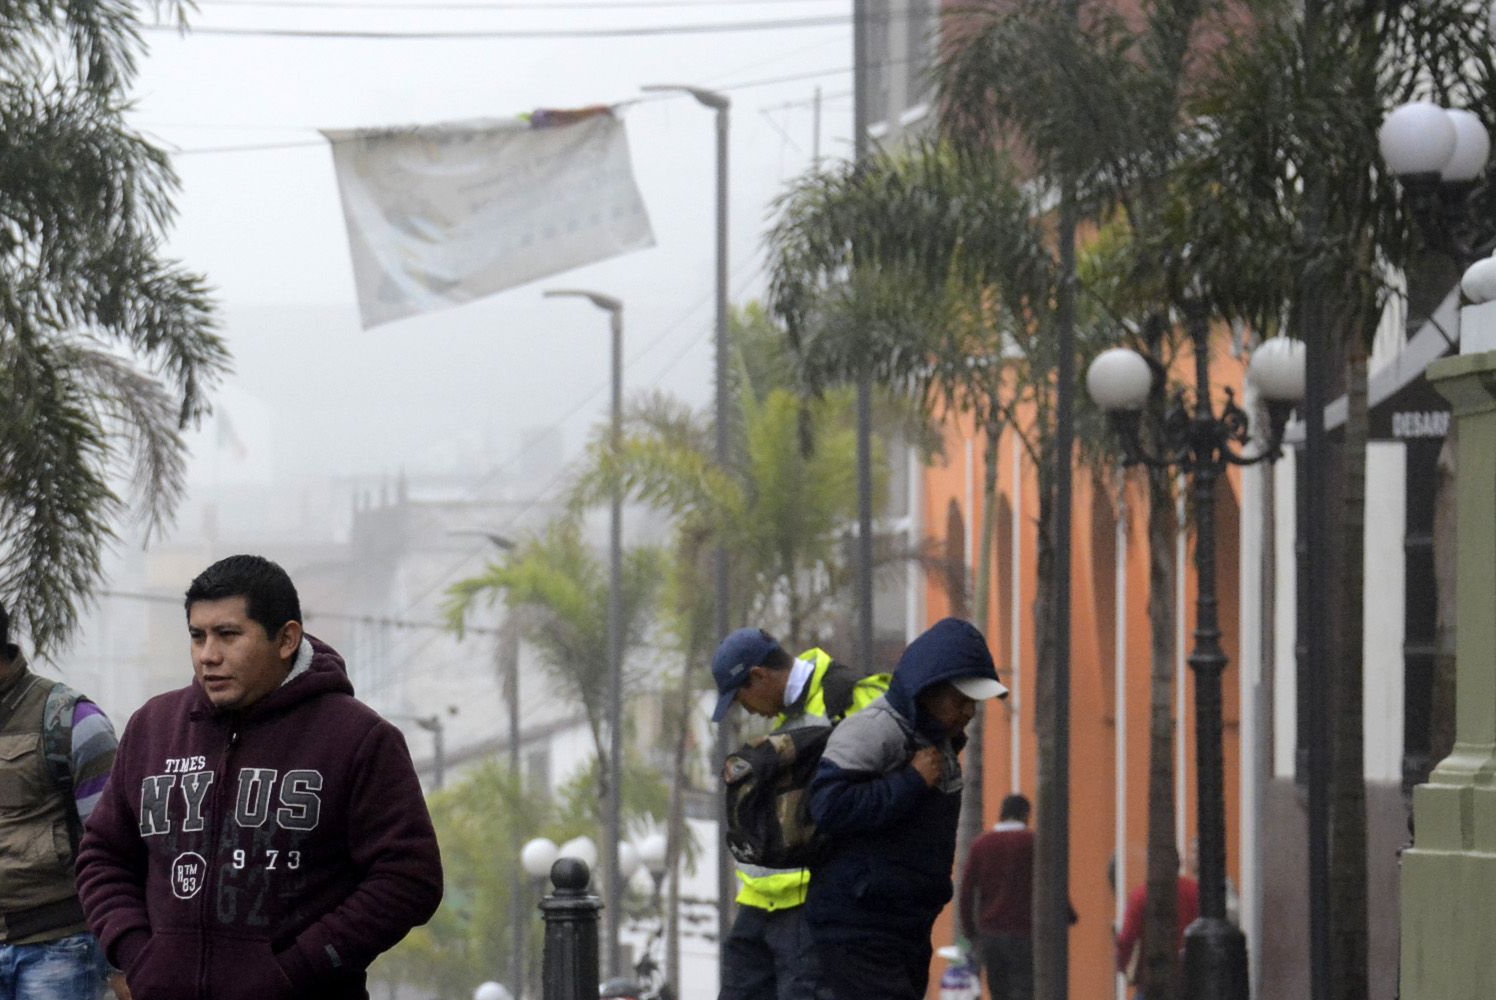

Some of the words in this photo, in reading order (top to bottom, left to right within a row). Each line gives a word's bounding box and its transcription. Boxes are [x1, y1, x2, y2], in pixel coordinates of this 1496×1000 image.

[164, 755, 206, 773] TIMES
[139, 770, 214, 837] NY
[234, 767, 324, 831] US
